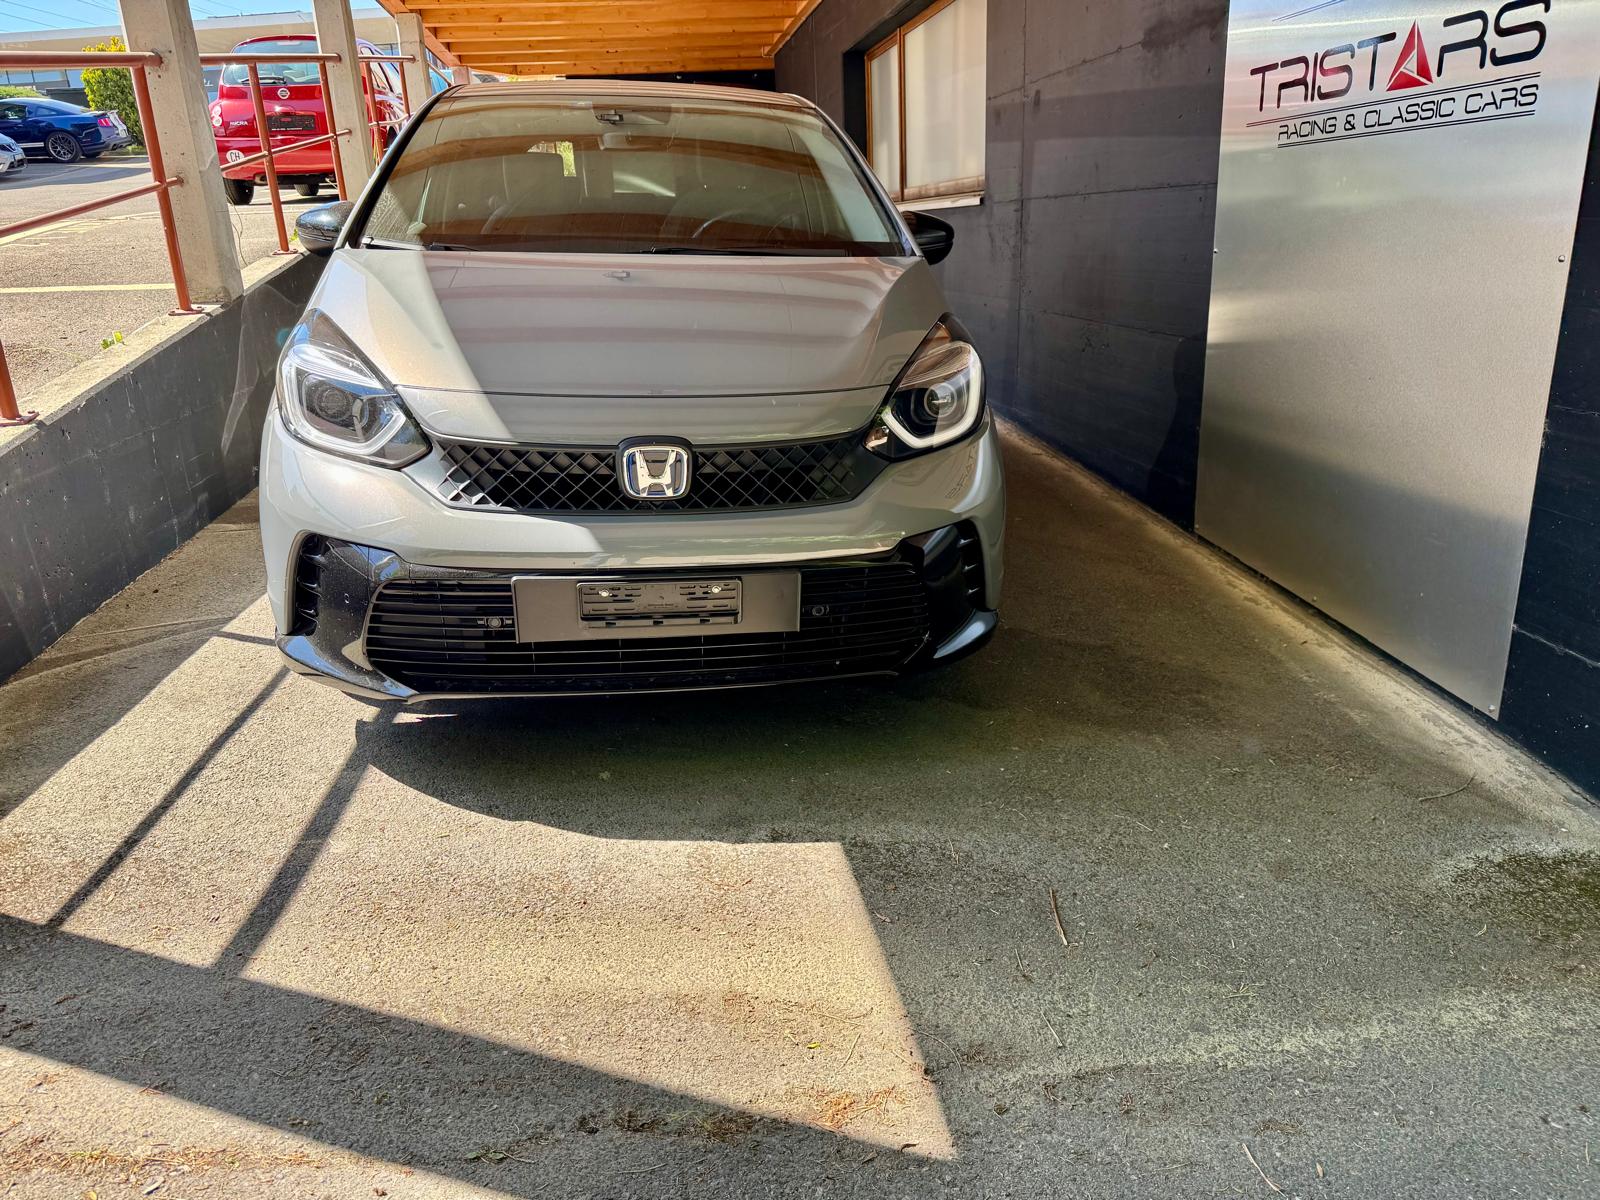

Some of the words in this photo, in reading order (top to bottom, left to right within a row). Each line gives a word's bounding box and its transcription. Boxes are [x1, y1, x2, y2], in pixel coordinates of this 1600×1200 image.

[1278, 116, 1337, 141] RACING
[1343, 113, 1356, 131] &
[1363, 97, 1455, 129] CLASSIC
[1464, 83, 1539, 113] CARS
[230, 151, 240, 162] CH
